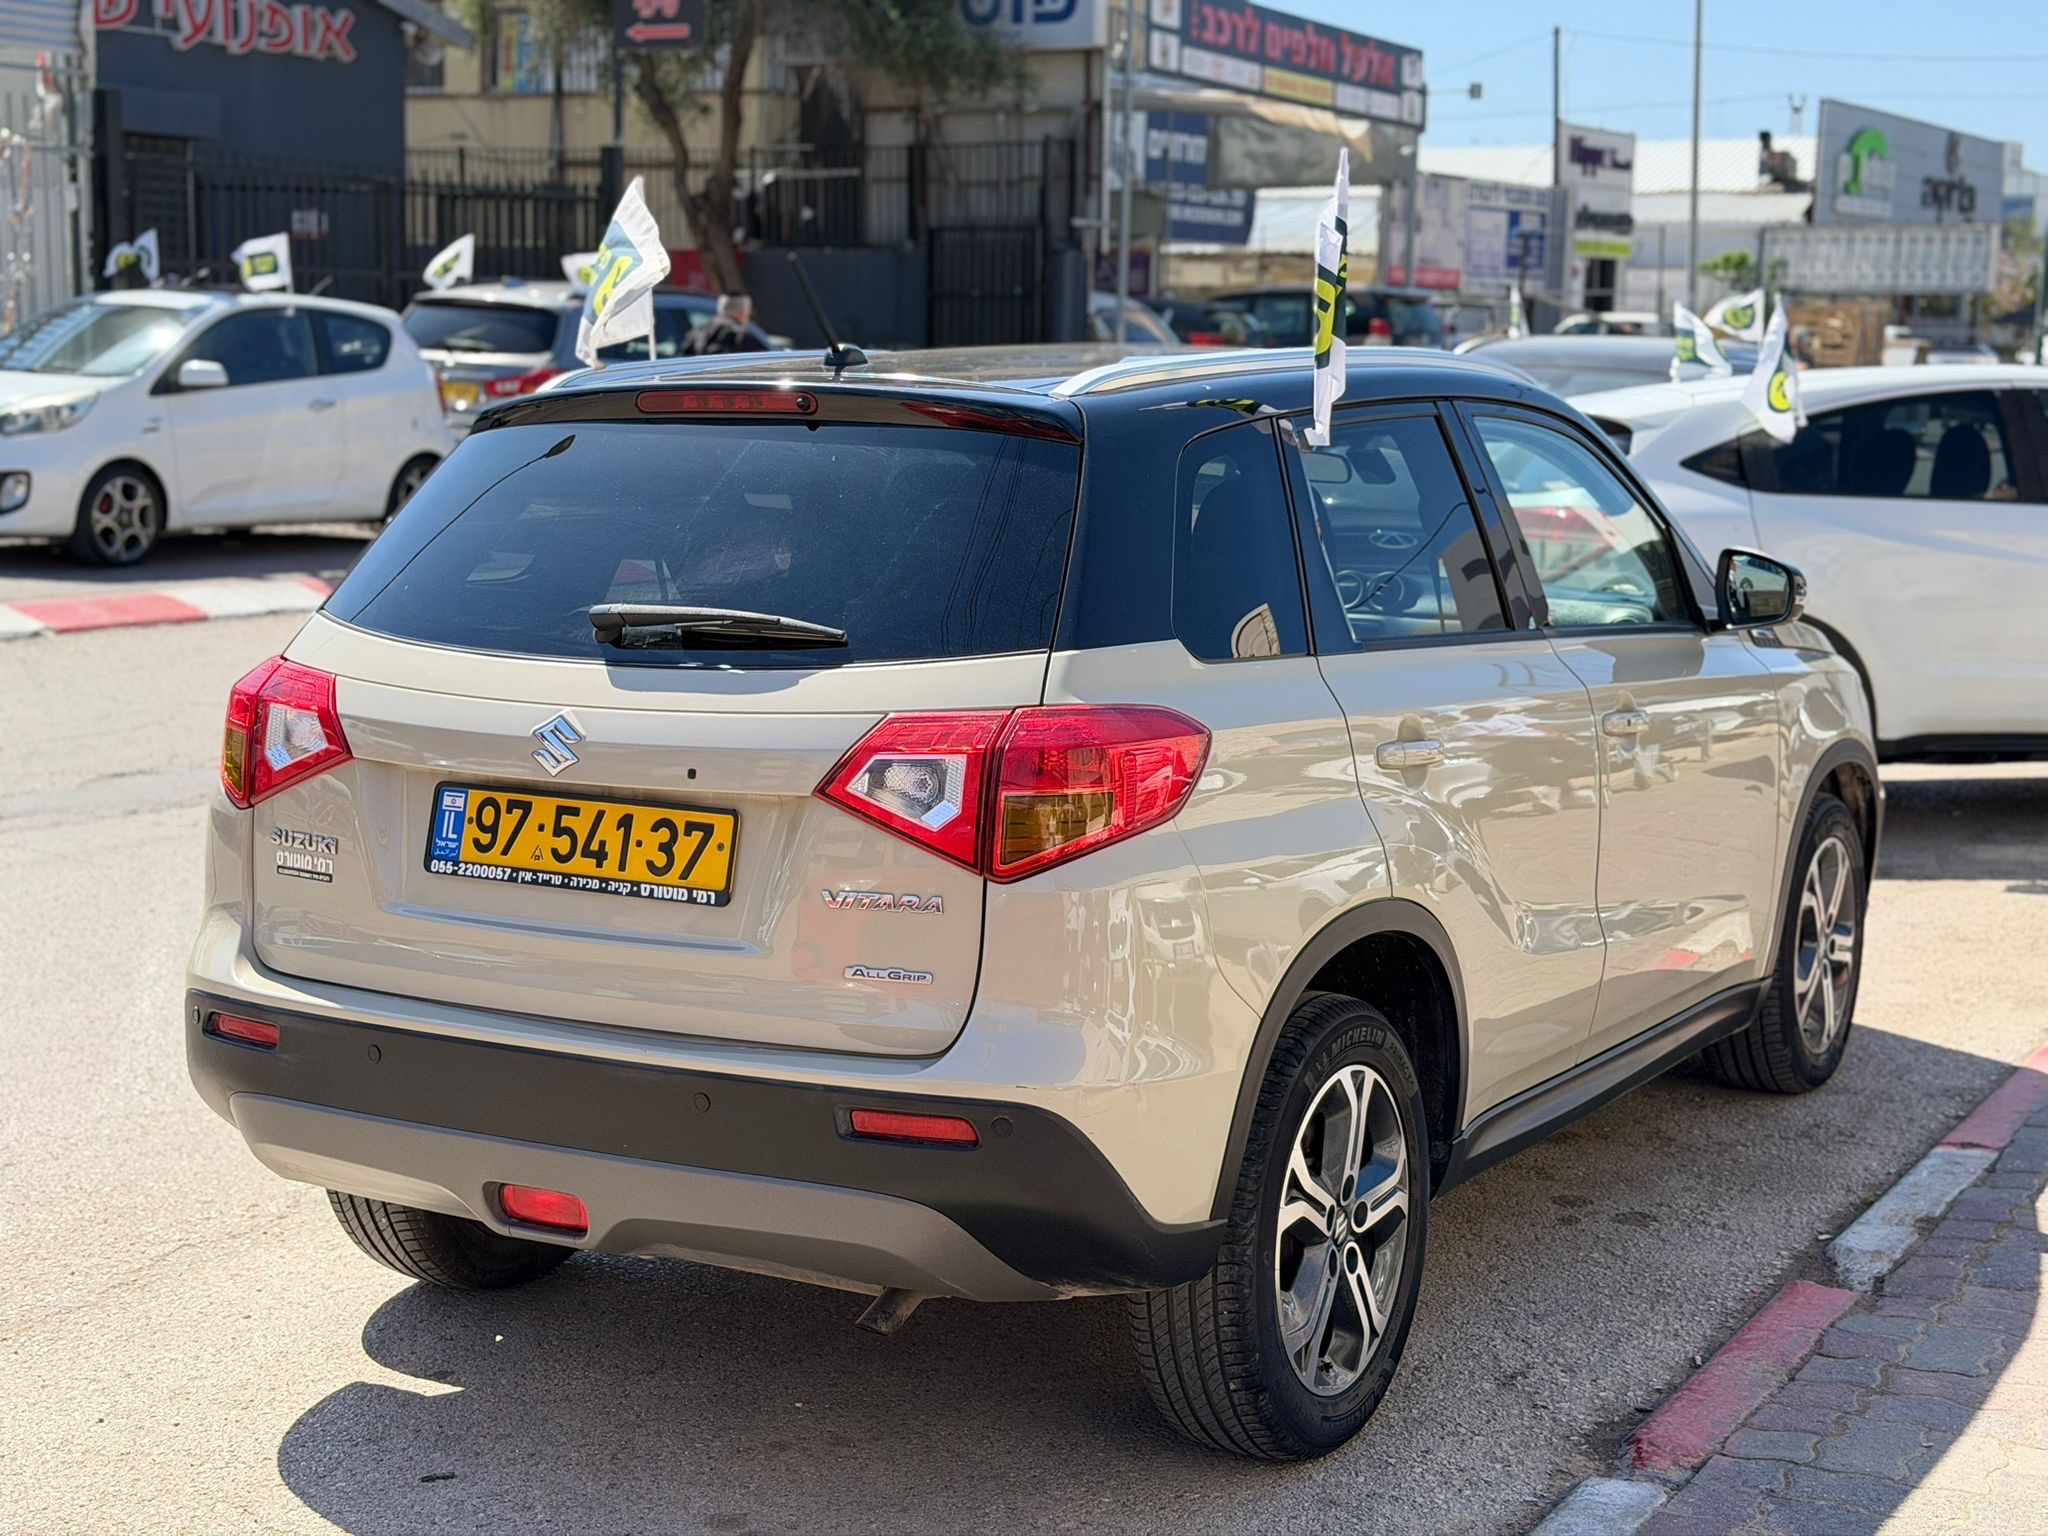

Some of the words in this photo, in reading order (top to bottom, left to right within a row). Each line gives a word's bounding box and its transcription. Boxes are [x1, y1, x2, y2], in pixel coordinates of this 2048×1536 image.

[442, 811, 458, 839] IL
[270, 826, 338, 855] SUZUKI
[276, 850, 313, 870] מוטורס
[314, 855, 334, 874] רמי
[430, 859, 512, 881] 055-2200057
[517, 870, 563, 885] טרייד-אין
[569, 876, 600, 890] מכירה
[607, 880, 631, 896] קניה
[640, 883, 689, 901] מוטורס
[693, 889, 716, 905] רמי
[821, 888, 944, 915] VITARA
[1331, 1026, 1386, 1057] MICHELIN
